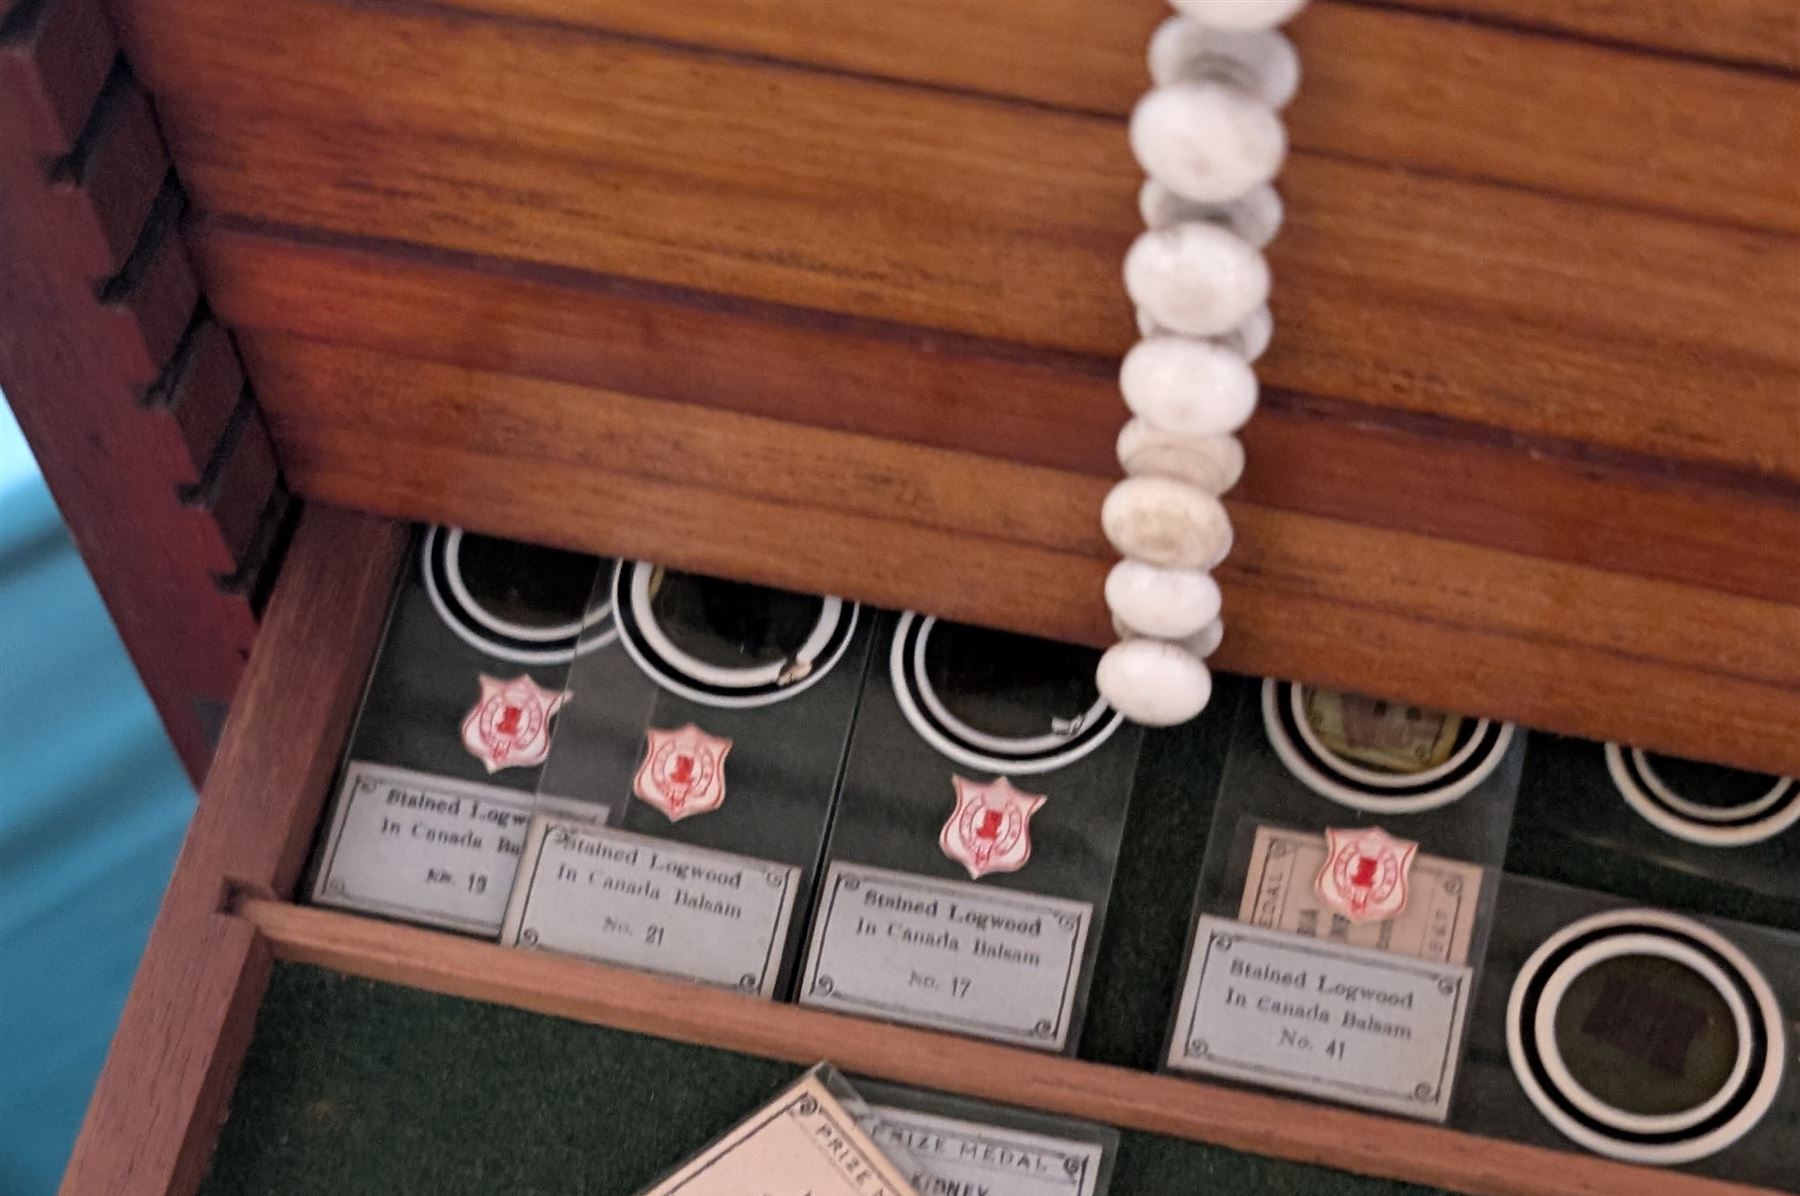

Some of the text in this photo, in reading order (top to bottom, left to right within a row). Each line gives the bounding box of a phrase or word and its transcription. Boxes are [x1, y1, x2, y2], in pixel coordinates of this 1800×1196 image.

[386, 788, 527, 827] Stained Logw
[381, 816, 401, 836] In
[411, 821, 483, 850] Canada
[566, 838, 742, 889] Stained Logwood
[557, 863, 742, 920] In Canada Balsam
[864, 888, 1042, 938] Stained Logwood
[646, 923, 665, 947] 21
[855, 916, 1041, 967] In Canada Balsam
[951, 976, 972, 999] 17
[1229, 957, 1415, 1011] Stained Logwood
[1224, 986, 1413, 1040] In Canada Balsam
[1277, 1027, 1347, 1060] No. 41
[816, 1122, 871, 1186] PRIZE
[959, 1144, 1048, 1173] MEDAL
